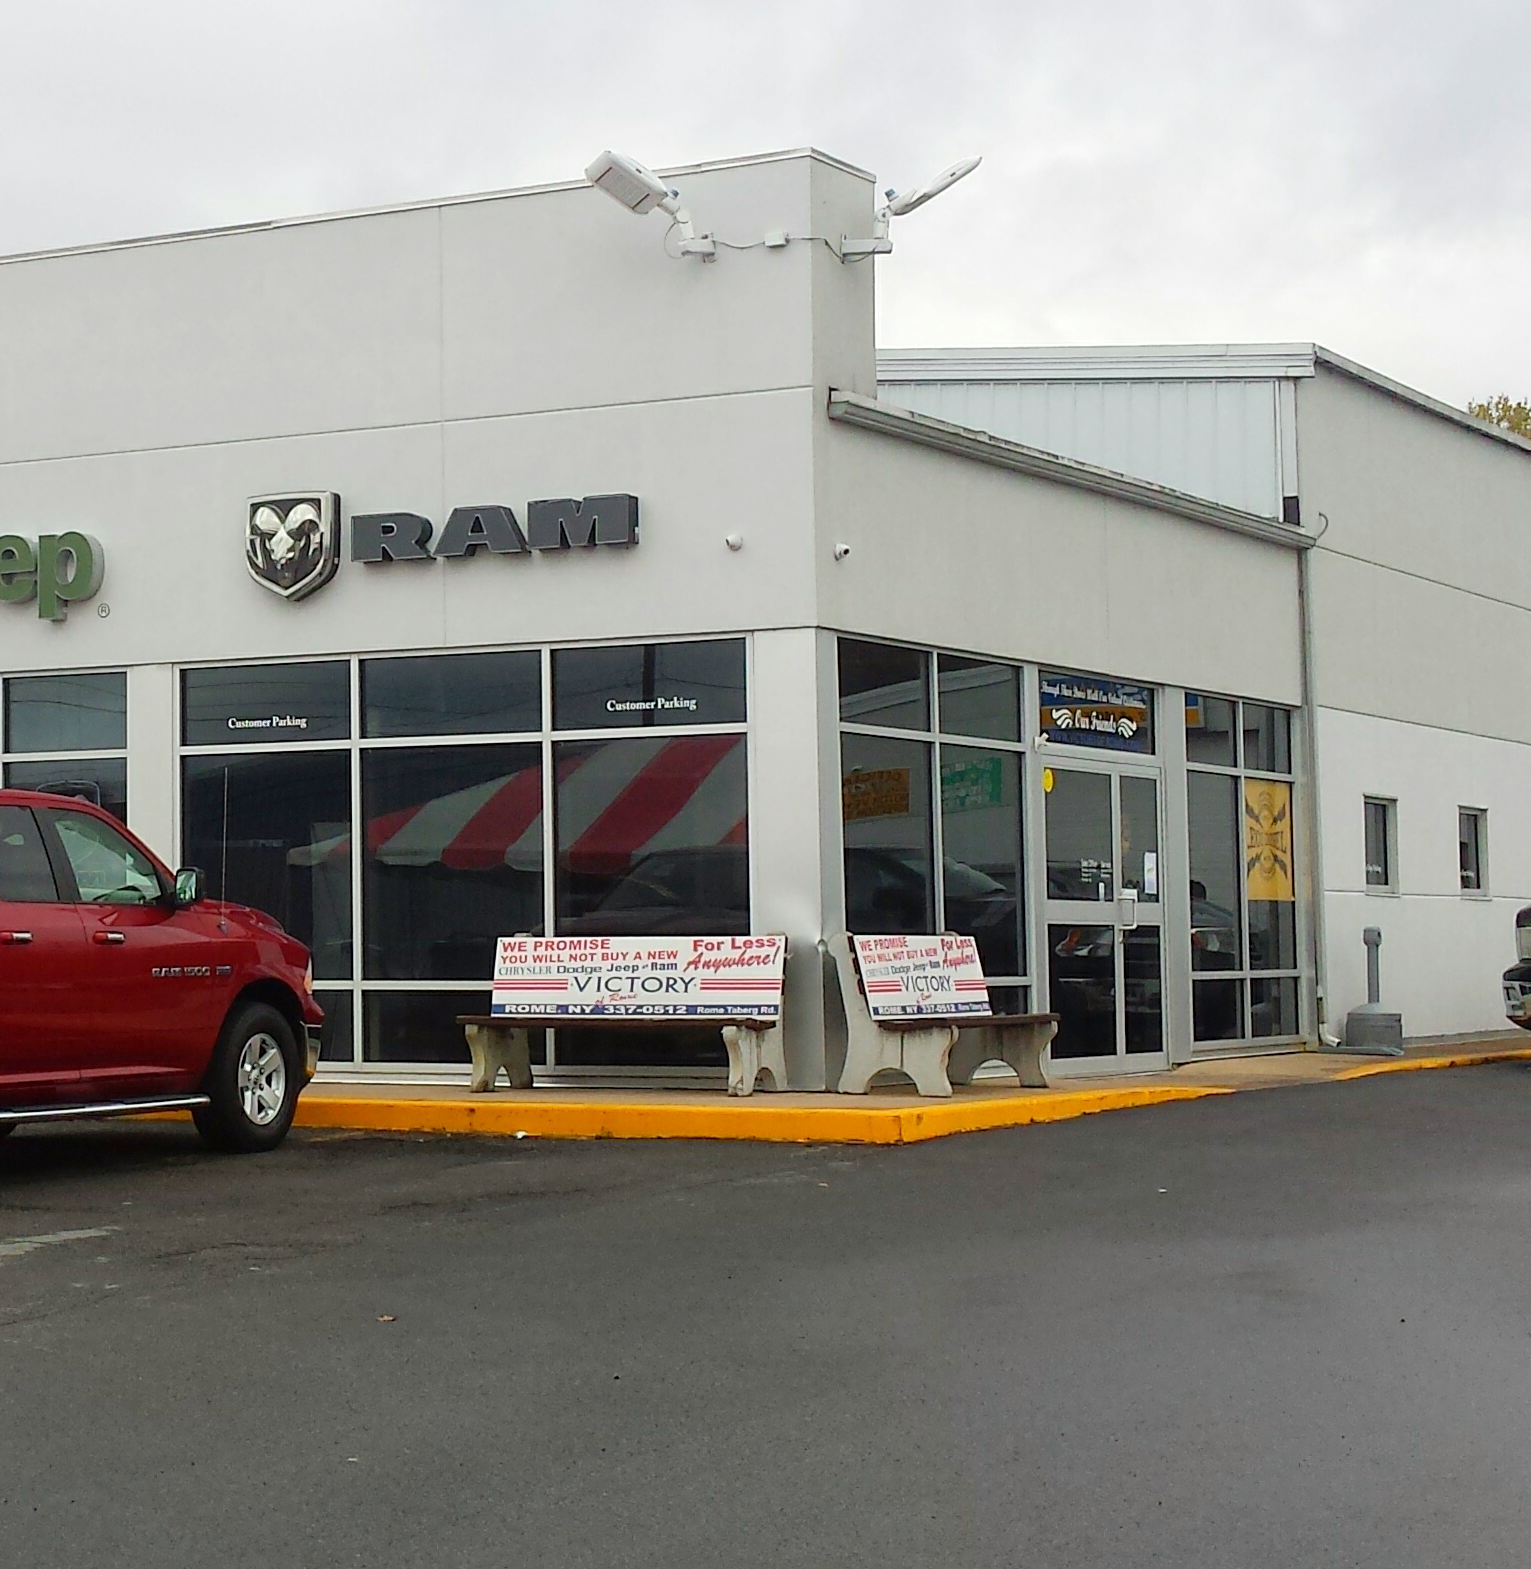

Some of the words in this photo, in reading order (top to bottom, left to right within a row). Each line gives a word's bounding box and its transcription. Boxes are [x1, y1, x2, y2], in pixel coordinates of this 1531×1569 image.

[351, 493, 639, 563] RAM
[607, 700, 656, 711] Customer
[657, 696, 697, 711] Parking
[228, 718, 271, 729] Customer
[272, 715, 307, 729] Parking
[502, 941, 527, 952] WE
[534, 938, 611, 951] PROMISE
[692, 939, 725, 952] For
[859, 941, 873, 951] WE
[874, 937, 908, 950] PROMISE
[940, 938, 953, 952] For
[501, 954, 528, 964] YOU
[532, 953, 564, 964] WILL
[569, 952, 597, 963] NOT
[601, 951, 629, 961] BUY
[633, 951, 643, 961] A
[647, 950, 679, 961] NEW
[683, 945, 781, 974] Anywhere!
[498, 965, 552, 976] CHRYSLER
[556, 964, 603, 975] Dodge
[606, 963, 640, 973] Jeep
[650, 961, 678, 972] Ram
[573, 976, 696, 993] VICTORY
[901, 975, 951, 993] VICTORY
[568, 1005, 593, 1014] NY
[603, 1005, 688, 1015] 337-0512
[696, 1006, 725, 1014] Rome
